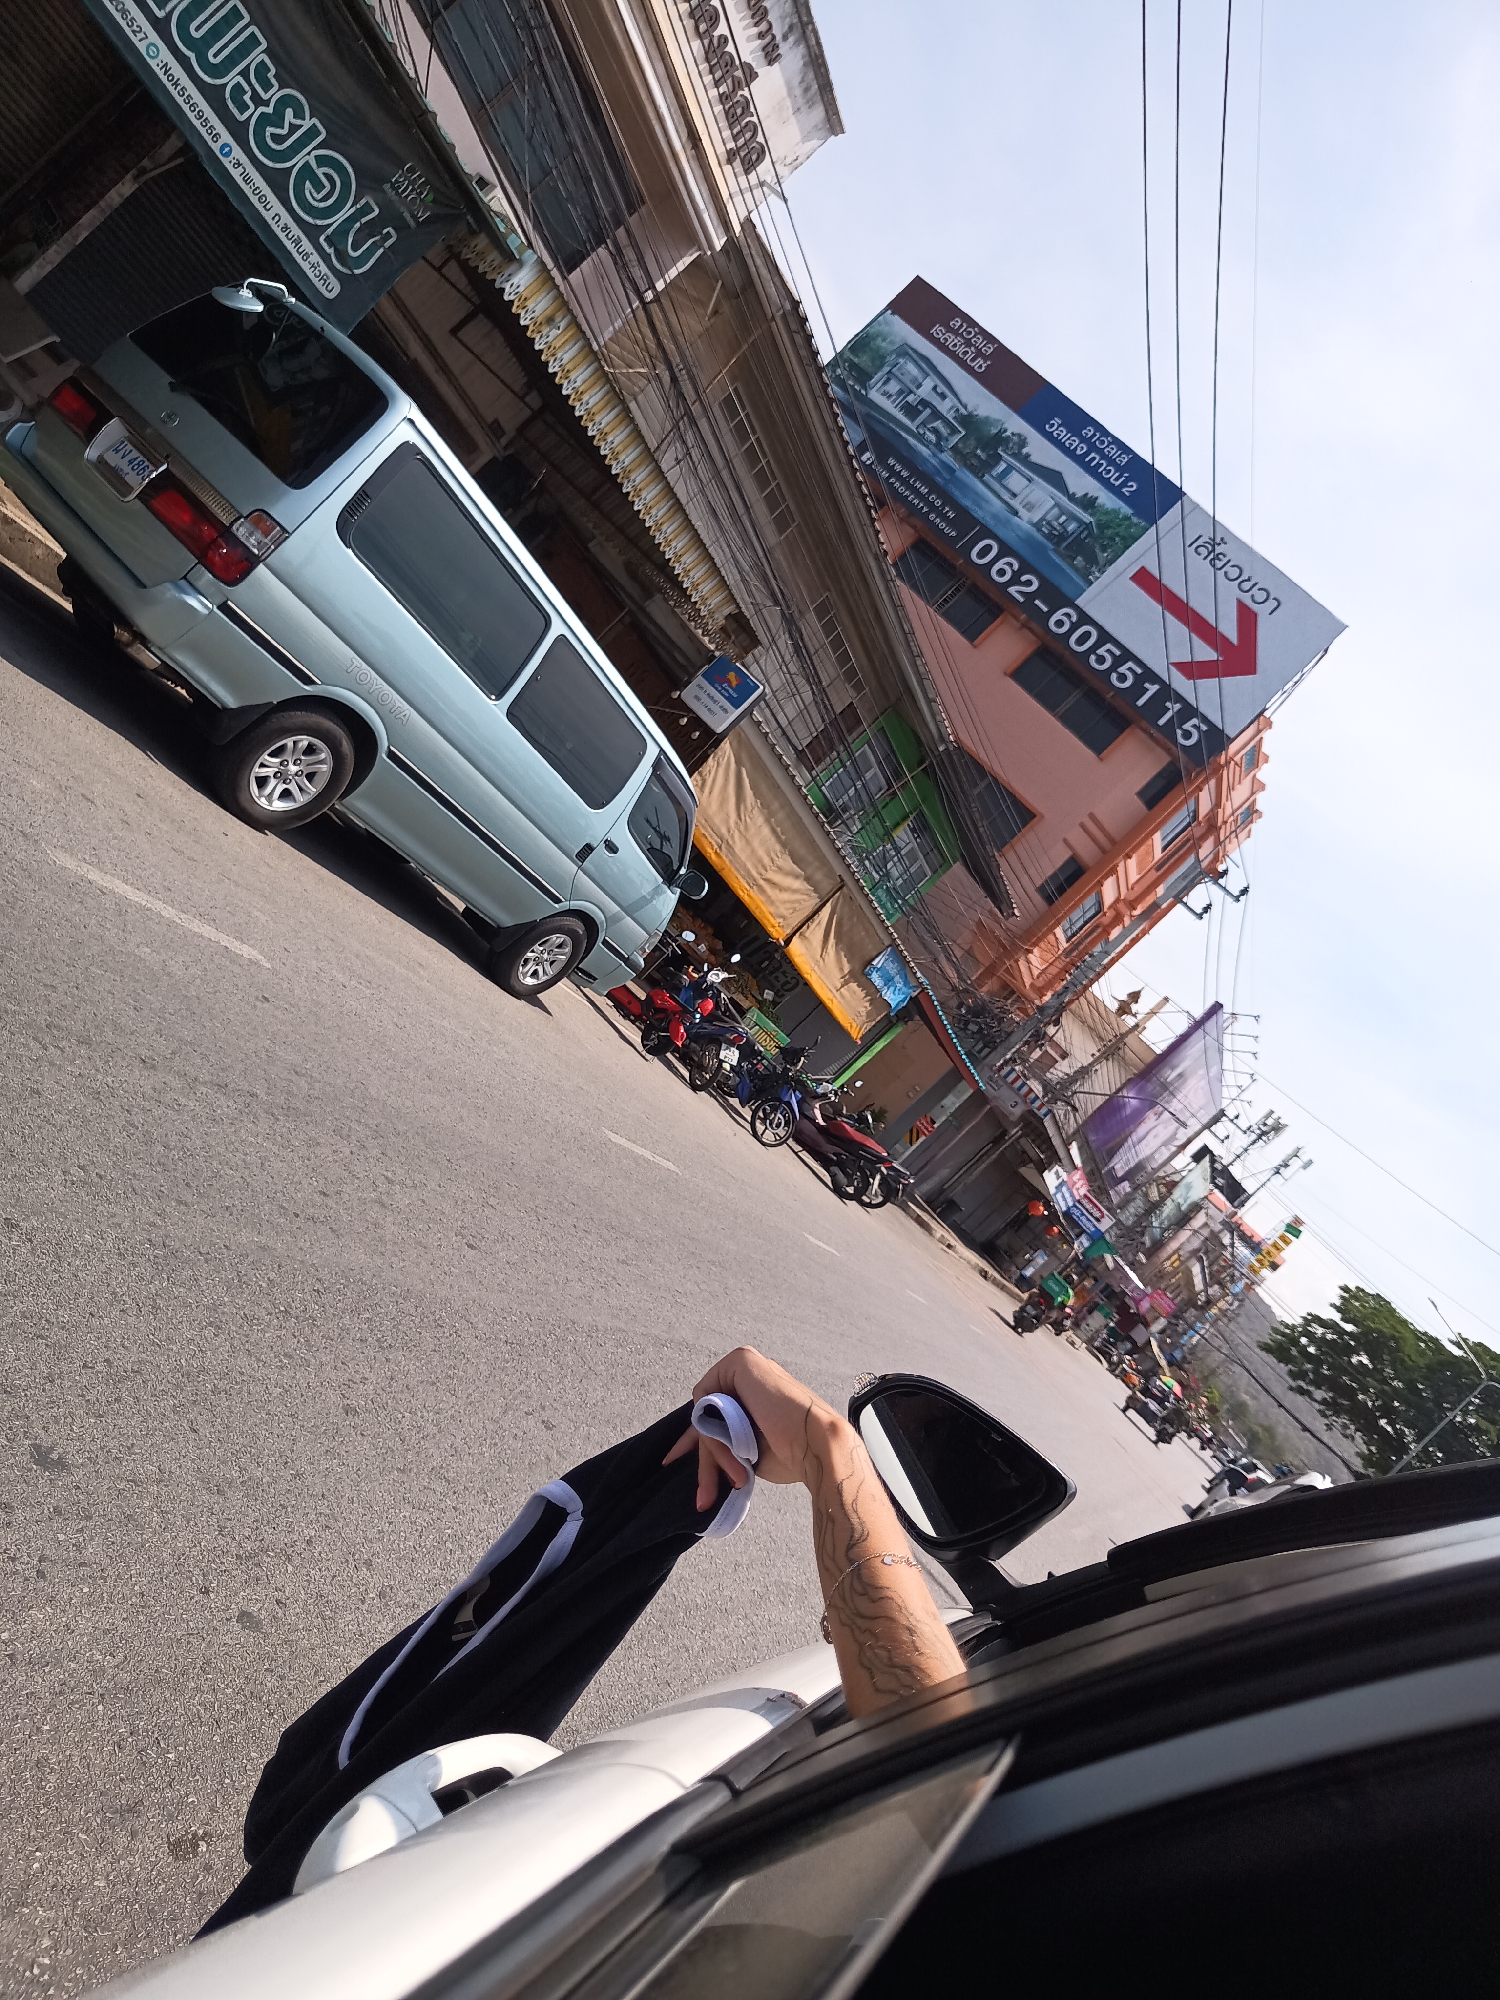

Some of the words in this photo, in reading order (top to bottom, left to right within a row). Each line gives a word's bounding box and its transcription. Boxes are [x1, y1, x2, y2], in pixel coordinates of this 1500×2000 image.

[146, 0, 398, 275] พะยอม
[949, 315, 998, 359] ลาวัลเล่
[1081, 423, 1132, 468] ลาวัลเล่
[1086, 450, 1127, 490] ทาวน์
[1124, 480, 1139, 497] 2
[886, 457, 957, 521] WWW.LHM.CO.TH
[888, 478, 928, 515] PROPERTY
[928, 510, 958, 538] GROUP
[1187, 533, 1283, 617] เลี้ยวขวา
[970, 538, 1208, 748] 062-6055115
[344, 657, 412, 727] TOYOTA
[1008, 1099, 1018, 1110] 3
